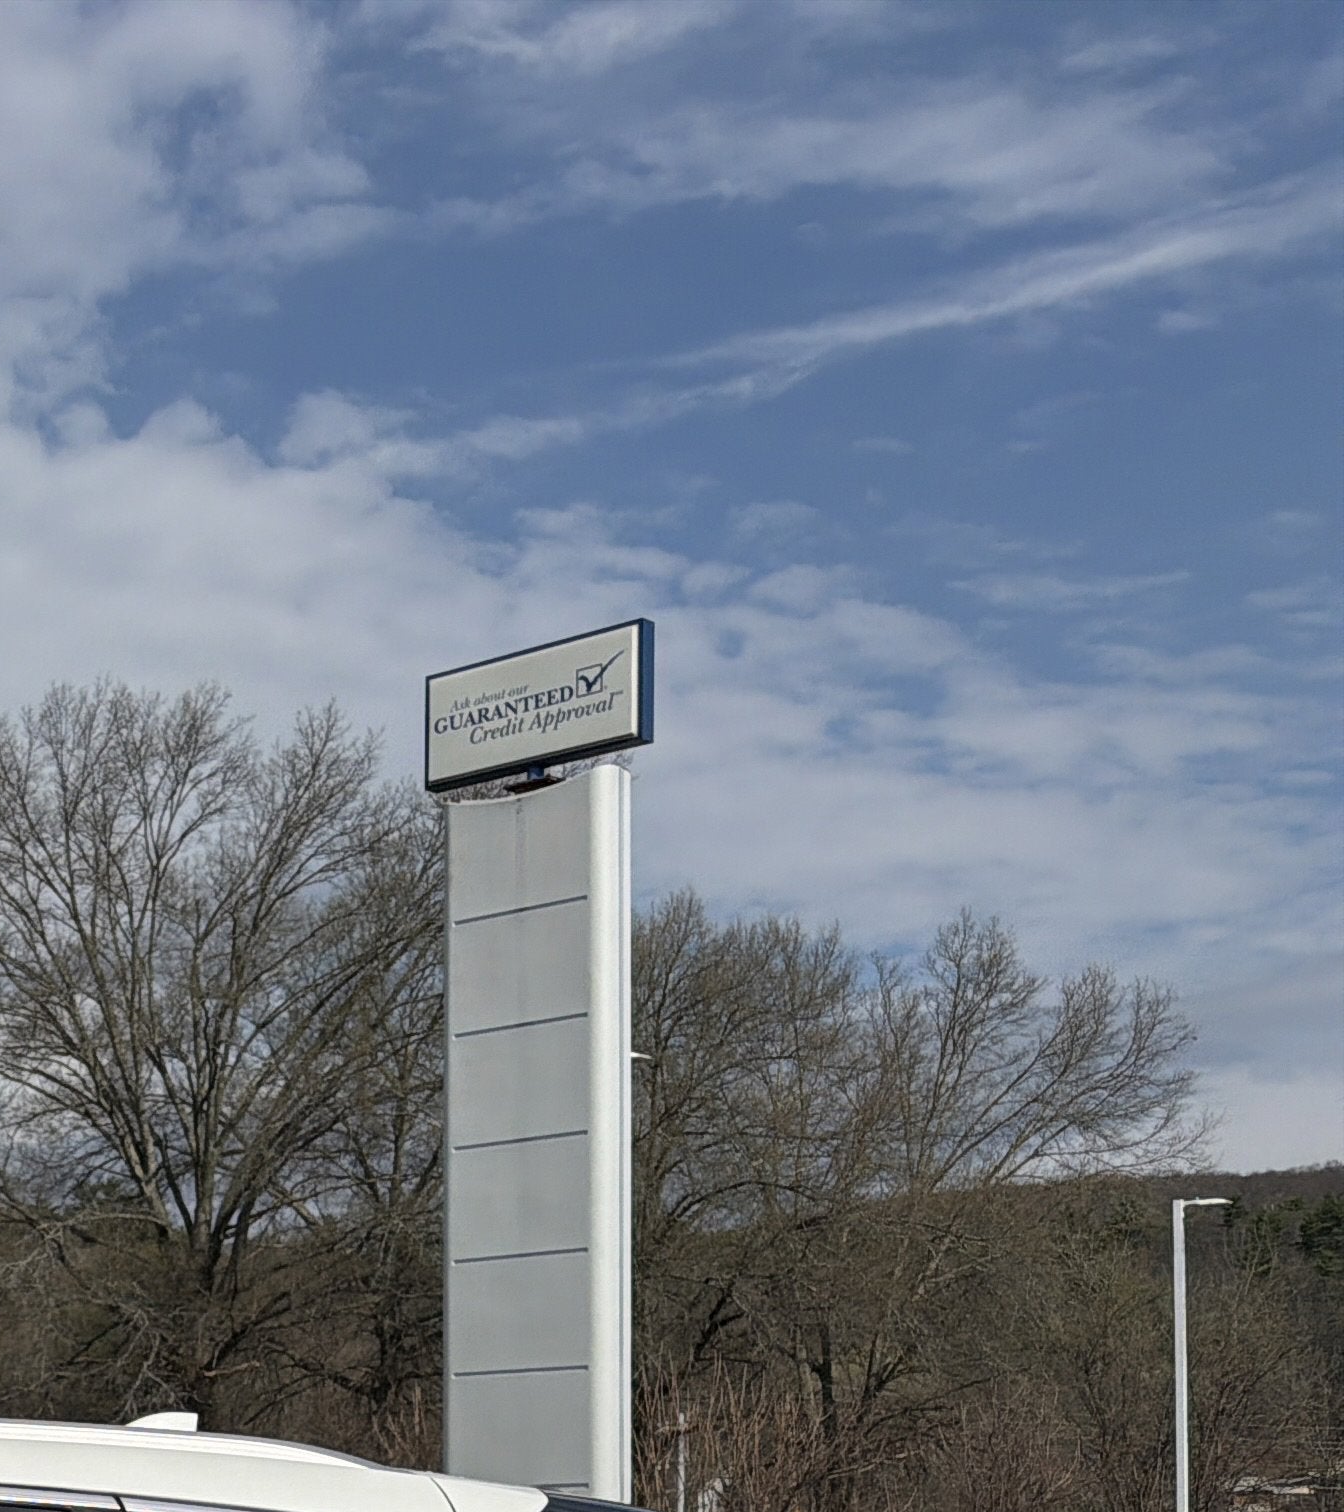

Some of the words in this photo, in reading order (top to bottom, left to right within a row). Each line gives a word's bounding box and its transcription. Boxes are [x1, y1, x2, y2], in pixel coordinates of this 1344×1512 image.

[433, 685, 574, 735] GUARANTEED
[450, 699, 472, 713] Ask
[473, 689, 507, 706] about
[508, 684, 530, 698] our
[469, 718, 525, 745] Credit
[529, 690, 624, 734] Approval
